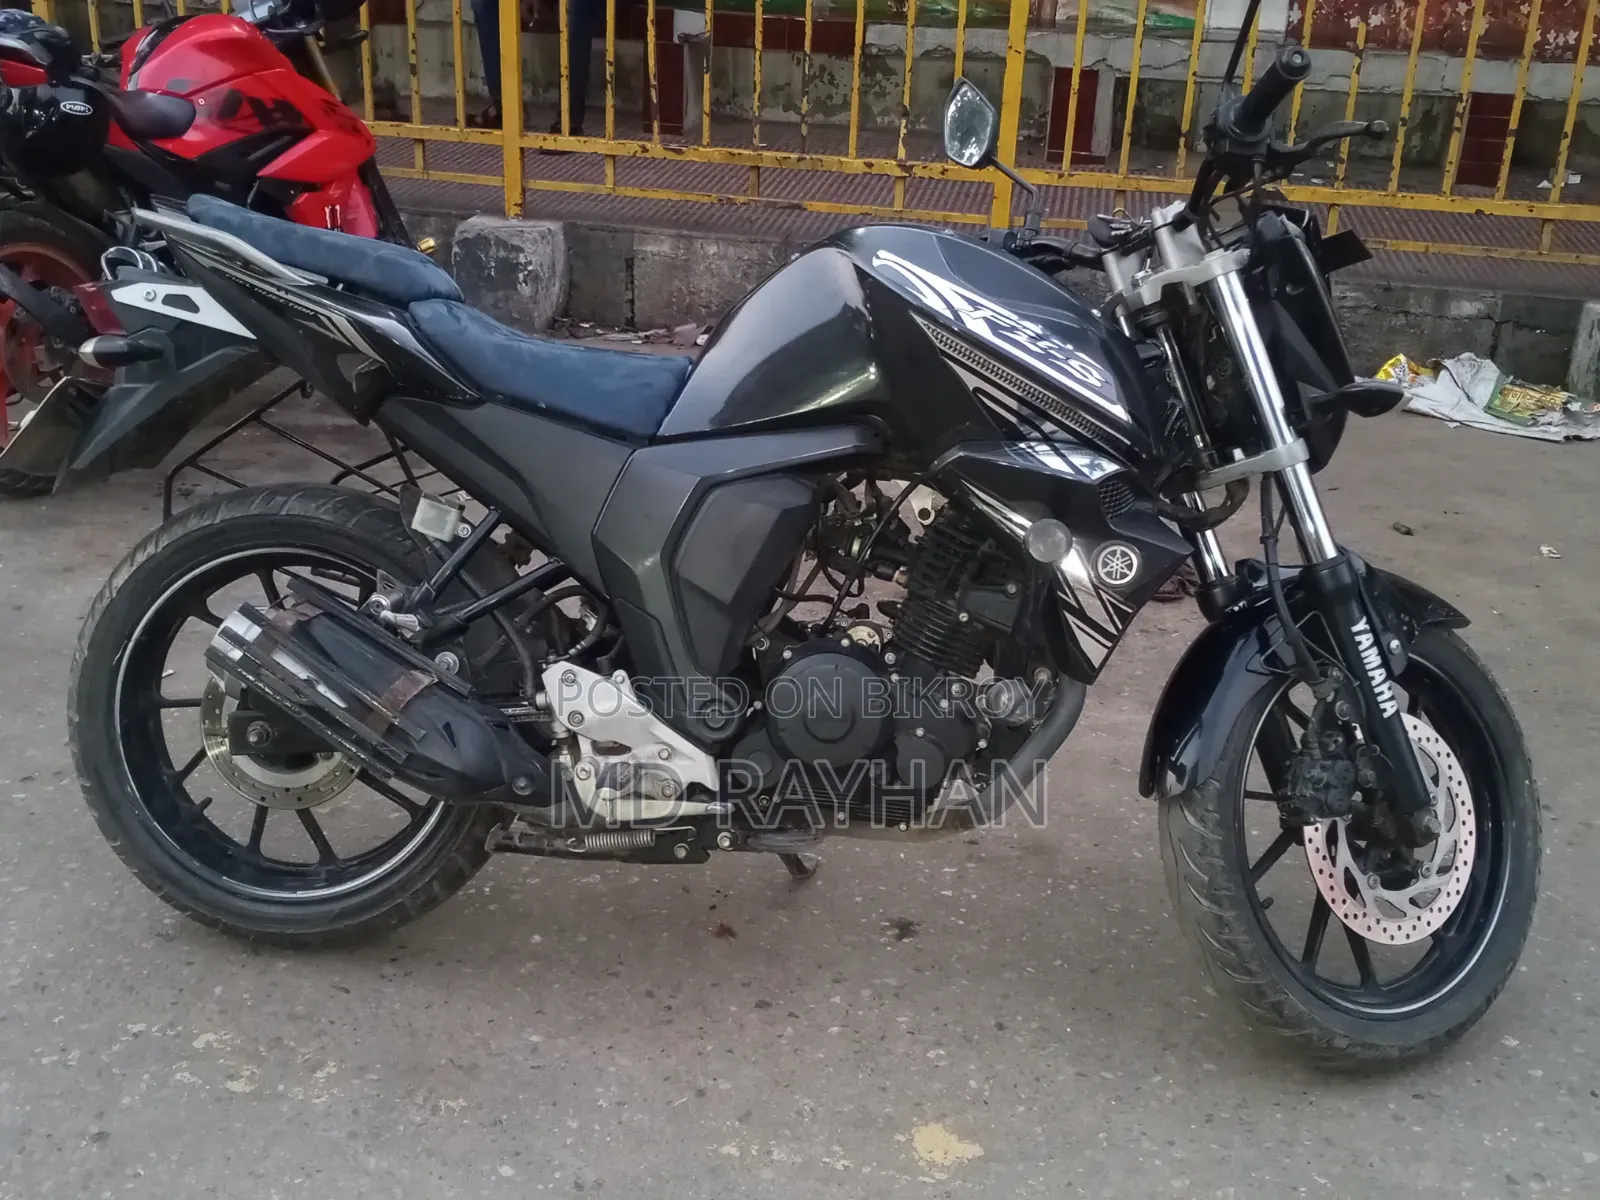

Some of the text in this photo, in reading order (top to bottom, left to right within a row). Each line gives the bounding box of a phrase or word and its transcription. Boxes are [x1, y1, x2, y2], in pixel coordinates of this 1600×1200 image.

[225, 273, 315, 316] FUEL INJECTION
[1350, 615, 1398, 719] YAMAHA
